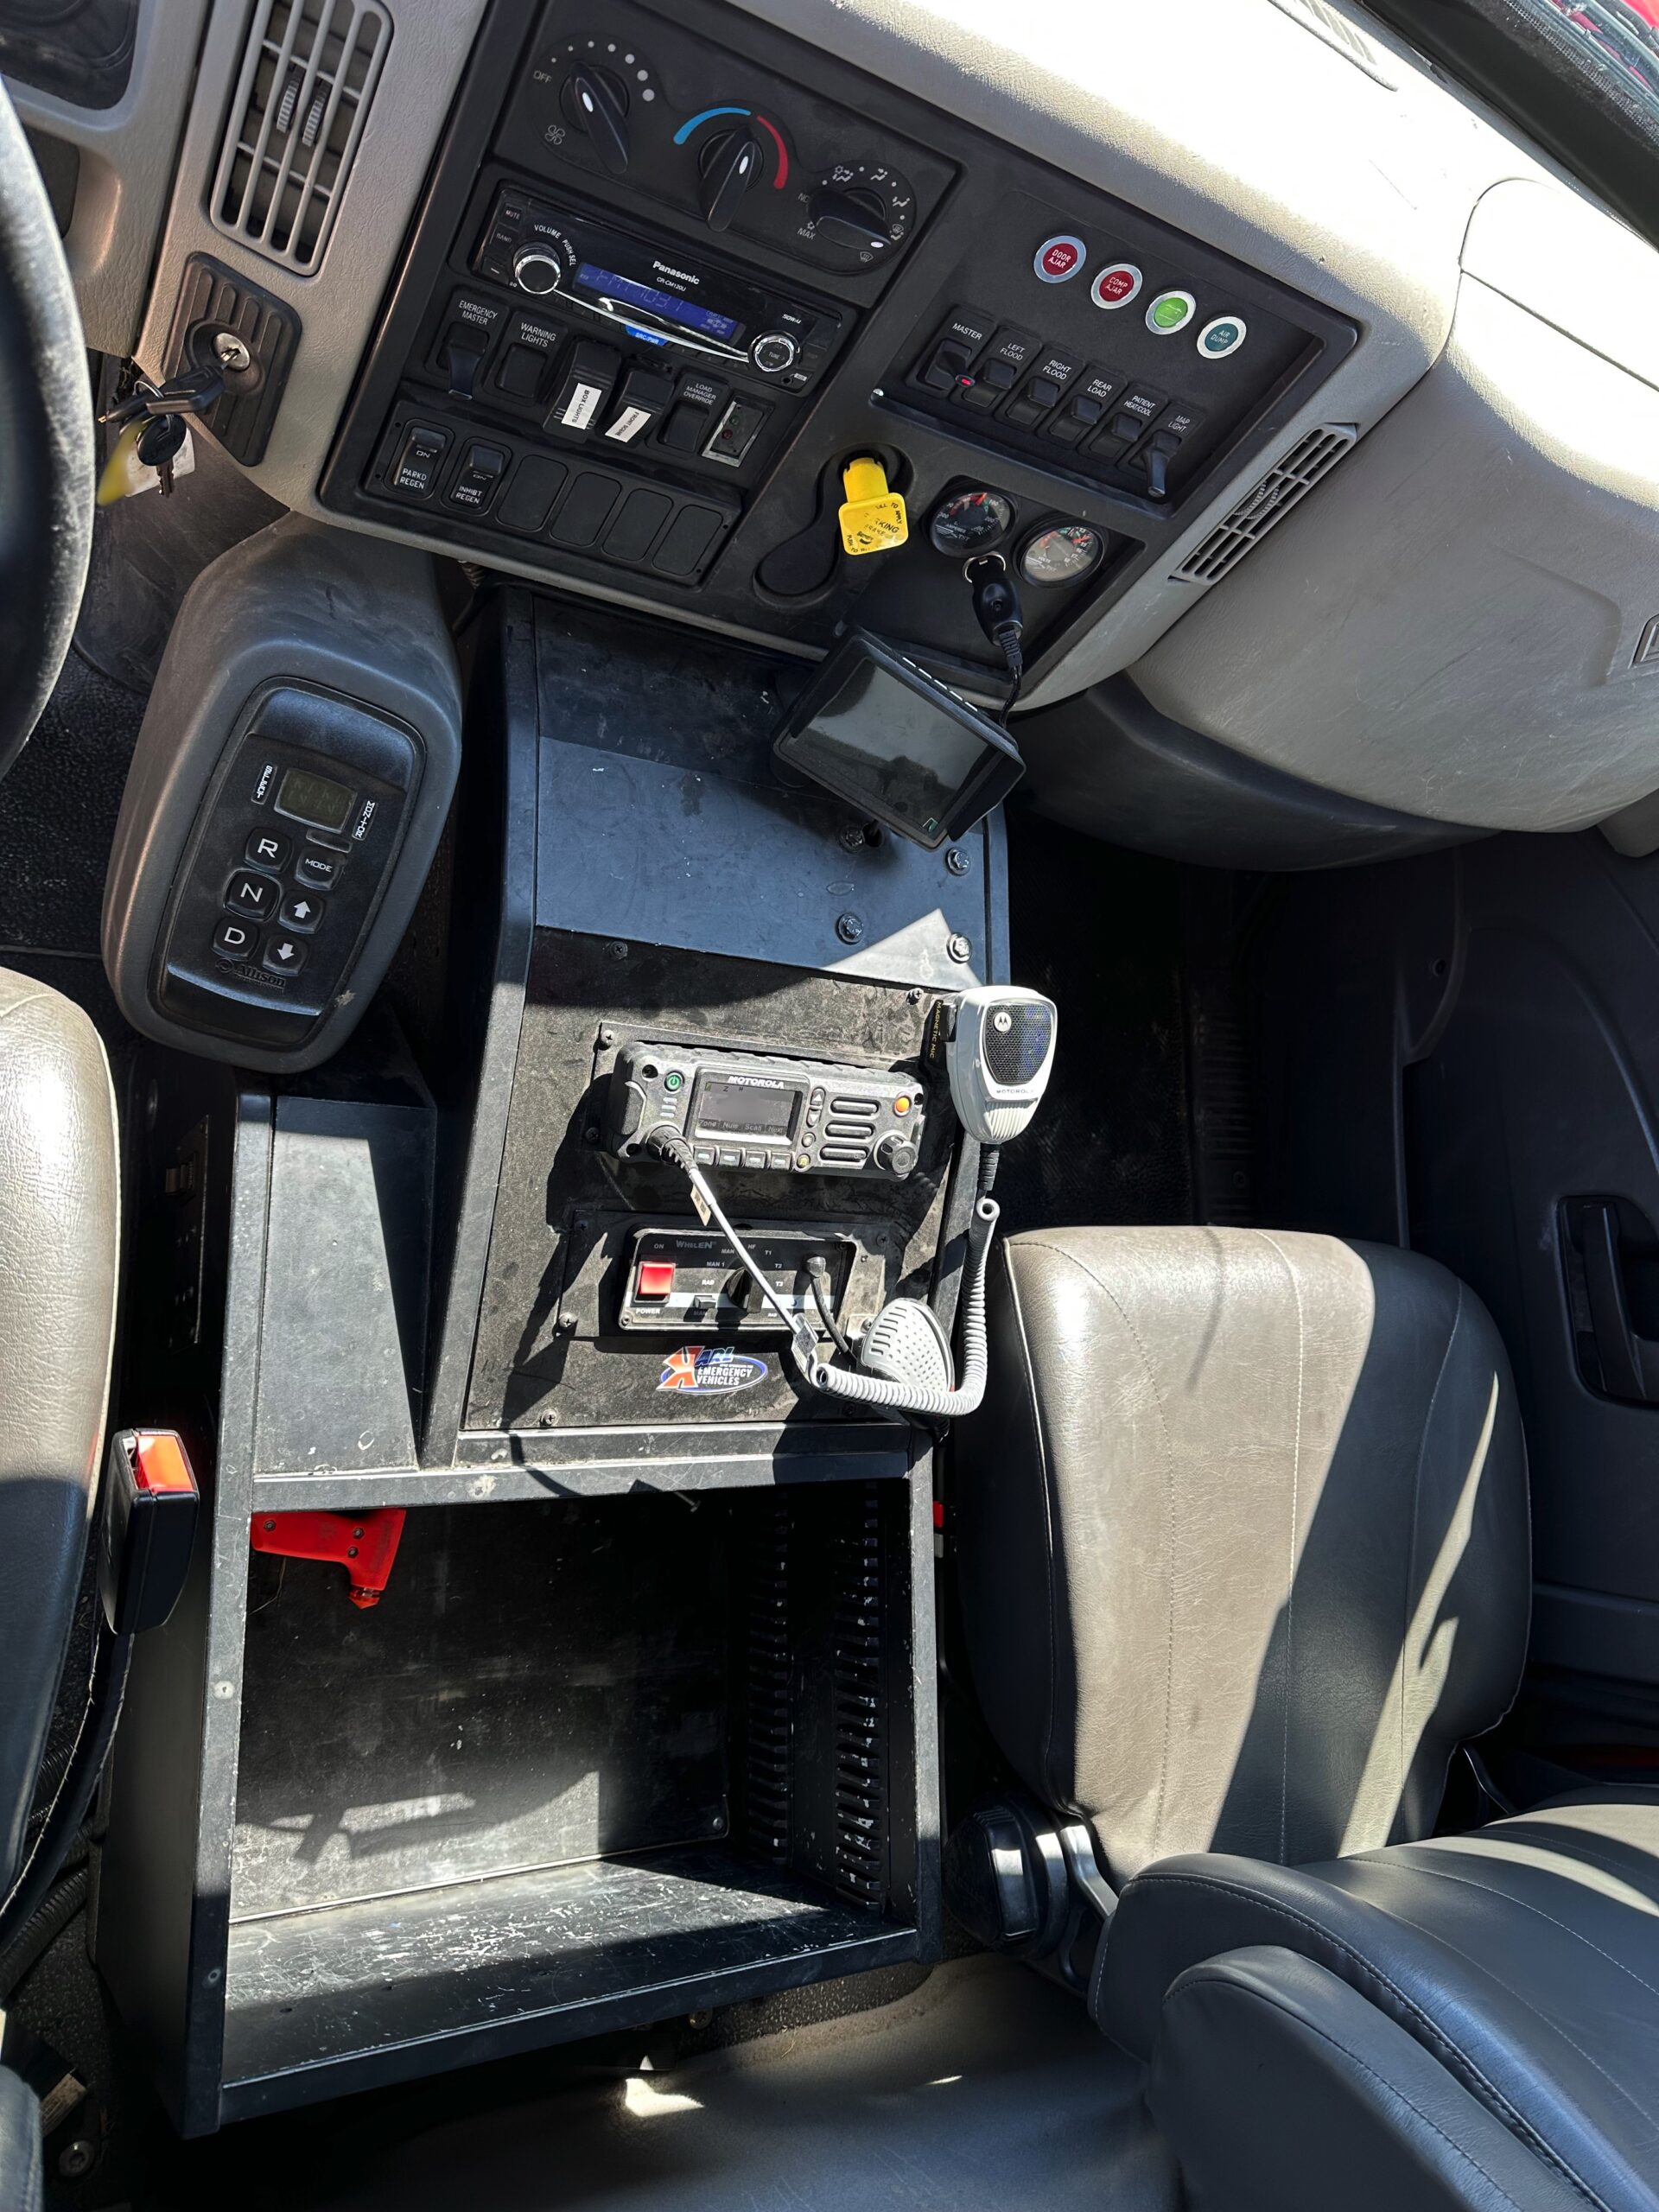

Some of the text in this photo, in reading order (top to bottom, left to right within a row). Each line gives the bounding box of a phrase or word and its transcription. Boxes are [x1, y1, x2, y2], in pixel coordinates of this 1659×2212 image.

[533, 70, 553, 84] OFF
[505, 209, 520, 220] MUTE
[534, 224, 562, 239] VOLUME
[797, 227, 817, 240] MAX
[562, 239, 574, 255] PUSH
[1047, 256, 1066, 270] AJAR
[1052, 249, 1071, 263] DOOR
[652, 260, 701, 285] Panasonic
[1105, 283, 1123, 296] AJAR
[1108, 276, 1129, 289] COMP
[458, 300, 499, 320] EMERGENCY
[461, 309, 488, 326] MASTER
[520, 321, 556, 342] WARNING
[951, 322, 983, 340] MASTER
[1219, 329, 1231, 338] AIR
[521, 332, 549, 347] LIGHTS
[1211, 334, 1229, 346] DUMP
[1000, 347, 1024, 361] FLOOD
[1007, 342, 1026, 353] LEFT
[1042, 365, 1067, 380] FLOOD
[1048, 359, 1072, 373] RIGHT
[695, 382, 714, 393] LOAD
[1087, 385, 1107, 397] LOAD
[1092, 378, 1112, 391] REAR
[580, 389, 590, 404] BOX
[683, 391, 714, 407] OVERRIDE
[686, 385, 717, 401] MANAGER
[1123, 400, 1153, 416] HEAT/COOL
[1131, 395, 1156, 410] PATIENT
[1167, 421, 1187, 433] LIGHT
[1175, 415, 1191, 425] MAP
[416, 449, 431, 459] ON
[402, 467, 428, 481] PARKD
[399, 476, 425, 490] REGEN
[455, 492, 480, 504] REGEN
[458, 485, 483, 497] INHIBT
[257, 765, 273, 799] SELECT
[354, 800, 376, 838] MONITOR
[257, 838, 278, 858] R
[305, 858, 333, 873] MODE
[240, 882, 264, 903] N
[224, 926, 246, 945] D
[931, 1001, 944, 1040] MAGNETIC
[929, 1042, 938, 1059] MIC
[727, 1076, 785, 1090] MOTOROLA
[700, 1118, 717, 1128] Zone
[697, 1366, 753, 1378] EMERGENCY
[696, 1375, 741, 1386] VEHICLES
